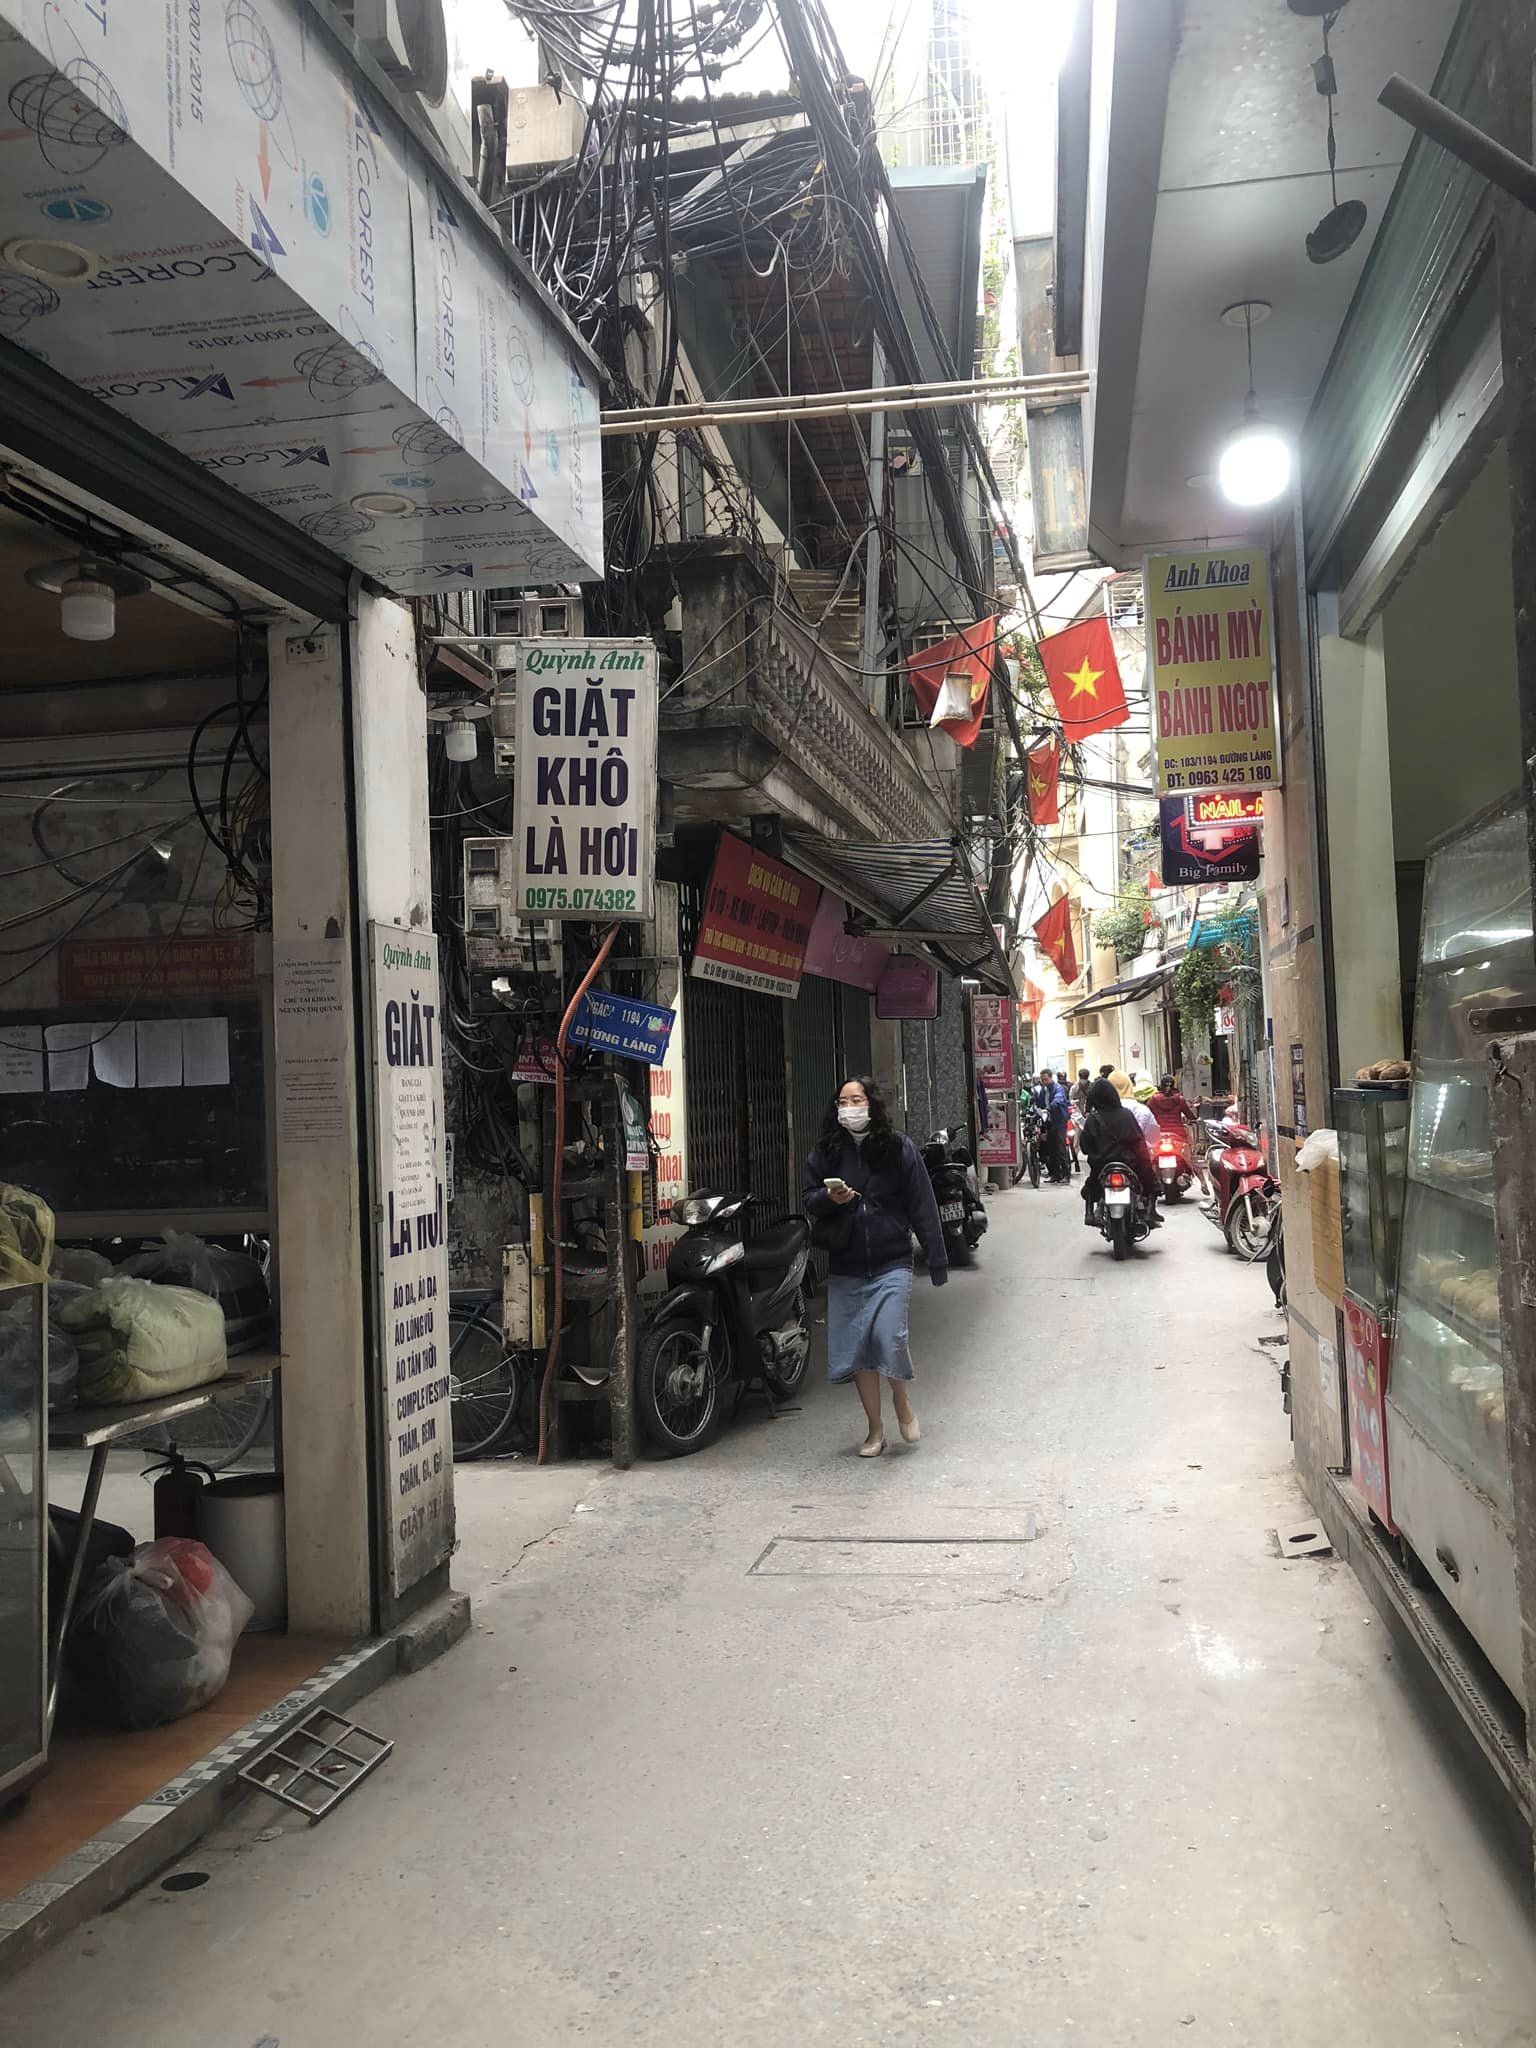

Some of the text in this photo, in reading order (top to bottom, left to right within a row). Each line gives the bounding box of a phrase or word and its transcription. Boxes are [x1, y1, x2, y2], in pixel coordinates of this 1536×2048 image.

[436, 180, 461, 387] ALCOREST
[1165, 559, 1250, 589] Anh Khoa
[1156, 606, 1220, 666] BÁNH
[525, 648, 644, 675] Quỳnh Anh
[533, 677, 635, 748] GIẶT
[1159, 678, 1270, 742] BÁNH NGỌT
[1250, 750, 1272, 762] LÁNG
[537, 747, 628, 807] KHÔ
[1189, 770, 1219, 786] 0963
[1223, 768, 1245, 783] 425
[1251, 765, 1271, 781] 180
[526, 816, 637, 877] LÀ HƠI
[1179, 862, 1248, 880] Big Family
[526, 888, 636, 910] 0975.074382
[414, 949, 432, 971] Anh
[622, 1037, 657, 1055] LÁNG
